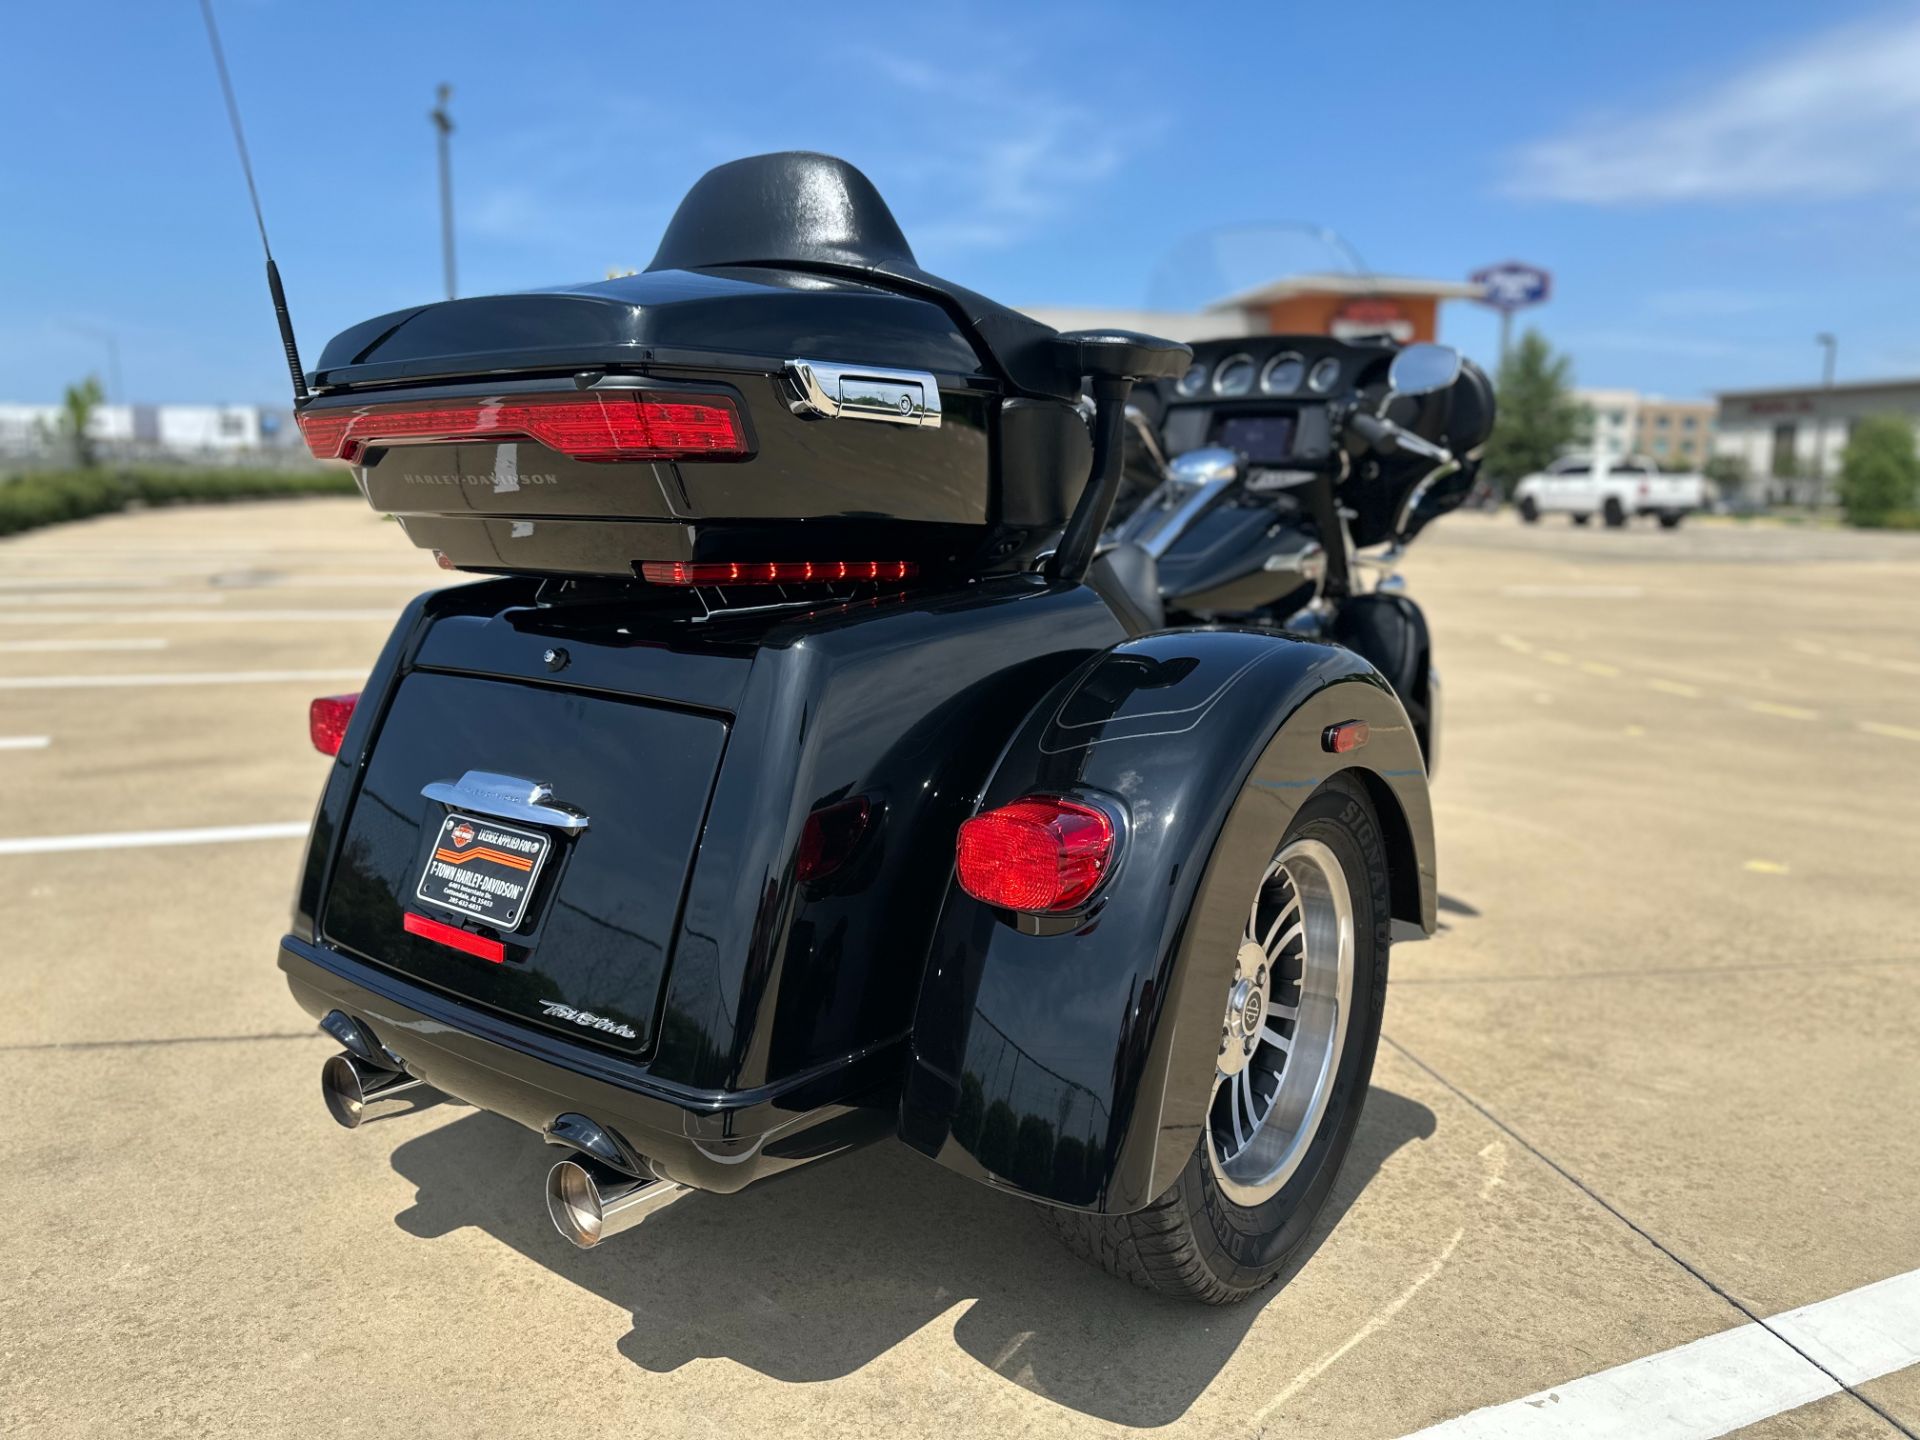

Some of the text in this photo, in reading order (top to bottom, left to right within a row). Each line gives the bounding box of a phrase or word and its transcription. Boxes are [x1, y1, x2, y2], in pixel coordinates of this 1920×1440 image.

[478, 829, 499, 843] LICENSE
[496, 833, 521, 849] APPLIED
[518, 839, 532, 852] FOR
[430, 861, 522, 899] T-TOWN HARLEY-DAVIDSON
